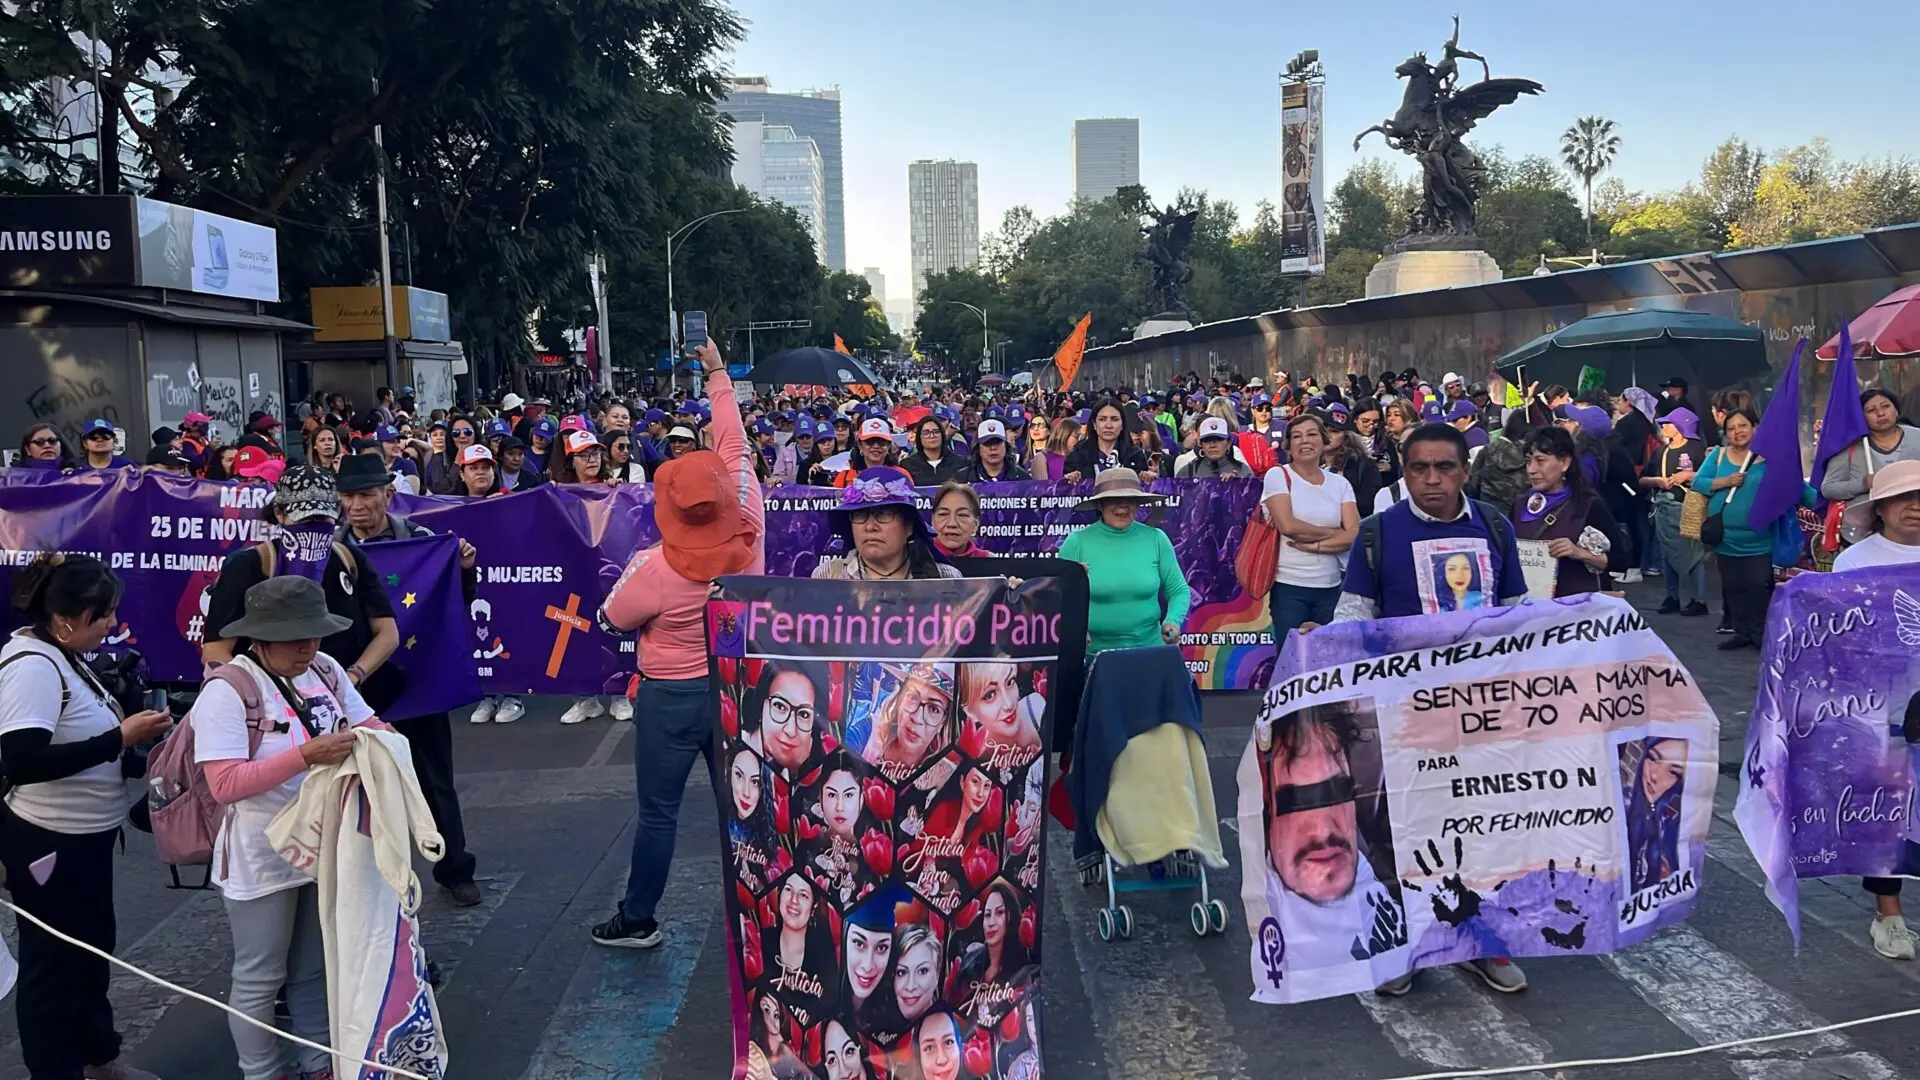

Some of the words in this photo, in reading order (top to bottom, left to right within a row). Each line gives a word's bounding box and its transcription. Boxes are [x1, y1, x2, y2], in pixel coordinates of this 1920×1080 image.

[783, 499, 791, 511] A
[794, 499, 809, 511] LA
[1030, 497, 1037, 508] E
[151, 516, 172, 538] 25
[178, 517, 204, 539] DE
[980, 525, 1021, 537] PORQUE
[1024, 525, 1044, 536] LES
[111, 553, 134, 568] DE
[140, 553, 160, 569] LA
[488, 566, 563, 583] MUJERES
[748, 601, 976, 644] Feminicidio
[1212, 633, 1225, 645] EN
[1230, 633, 1257, 645] TODO
[1260, 633, 1274, 644] EL
[1352, 653, 1421, 682] PARA
[1430, 632, 1535, 668] MELANI
[1413, 675, 1577, 711] SENTENCIA
[1596, 664, 1687, 693] MÁXIMA
[1461, 709, 1501, 734] DE
[1521, 704, 1558, 728] 70
[1579, 694, 1645, 723] AÑOS
[1417, 755, 1459, 772] PARA
[1451, 768, 1568, 798] ERNESTO
[1577, 766, 1597, 787] N
[1441, 815, 1485, 838] POR
[1489, 806, 1614, 833] FEMINICIDIO
[902, 831, 968, 873] Justicia
[769, 955, 823, 998] Justicia
[958, 981, 1015, 1016] Justicia
